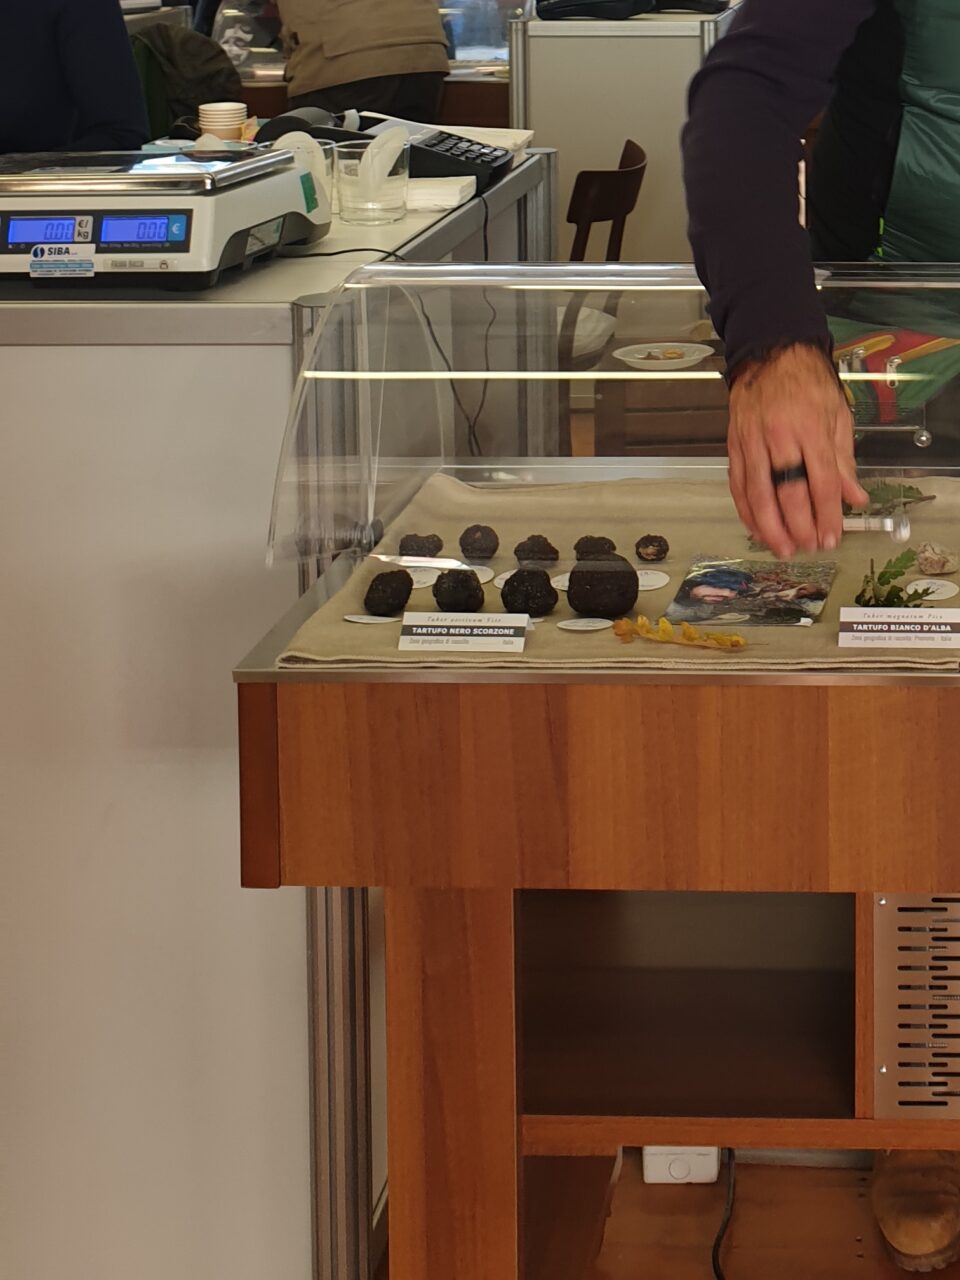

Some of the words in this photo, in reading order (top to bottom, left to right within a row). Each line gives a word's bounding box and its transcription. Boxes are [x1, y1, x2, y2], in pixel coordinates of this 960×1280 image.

[172, 223, 181, 234] €
[77, 229, 89, 240] kg
[47, 246, 71, 256] SIBA
[412, 626, 448, 635] TARTUFO
[449, 627, 472, 635] NERO
[472, 628, 515, 636] SCORZONE
[852, 623, 888, 631] TARTUFO
[890, 623, 921, 631] BIANCO
[923, 624, 952, 632] D'ALBA
